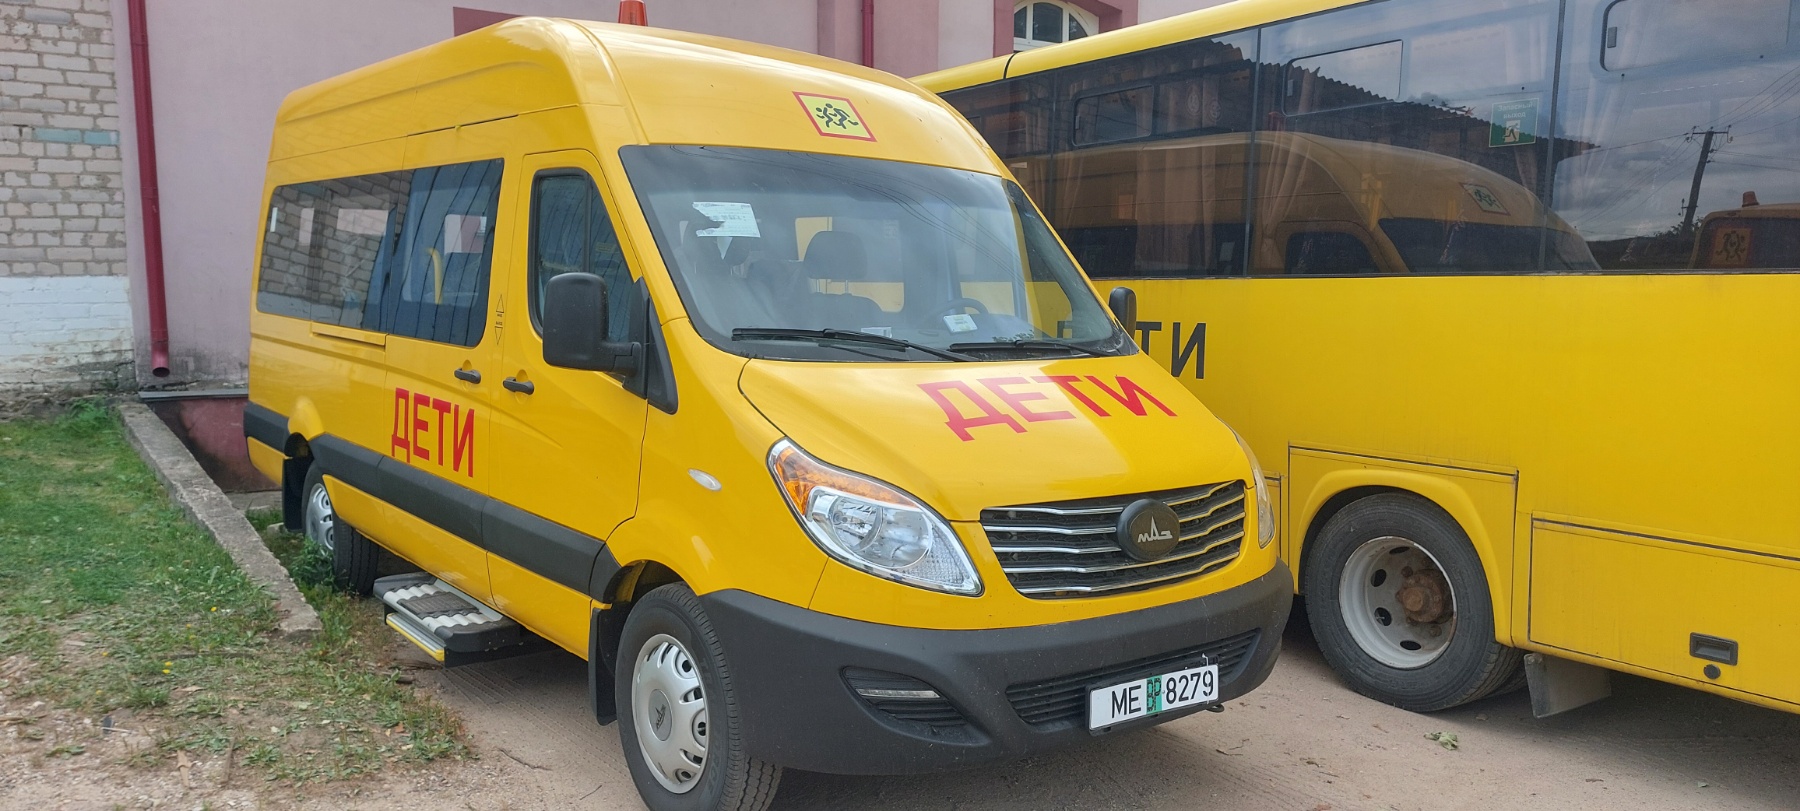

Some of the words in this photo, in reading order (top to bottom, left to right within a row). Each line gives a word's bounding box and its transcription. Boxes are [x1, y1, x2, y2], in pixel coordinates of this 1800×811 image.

[391, 387, 475, 478] ДЕТИ
[916, 375, 1178, 442] ДЕТИ
[1111, 684, 1142, 719] ME
[1166, 670, 1214, 705] 8279
